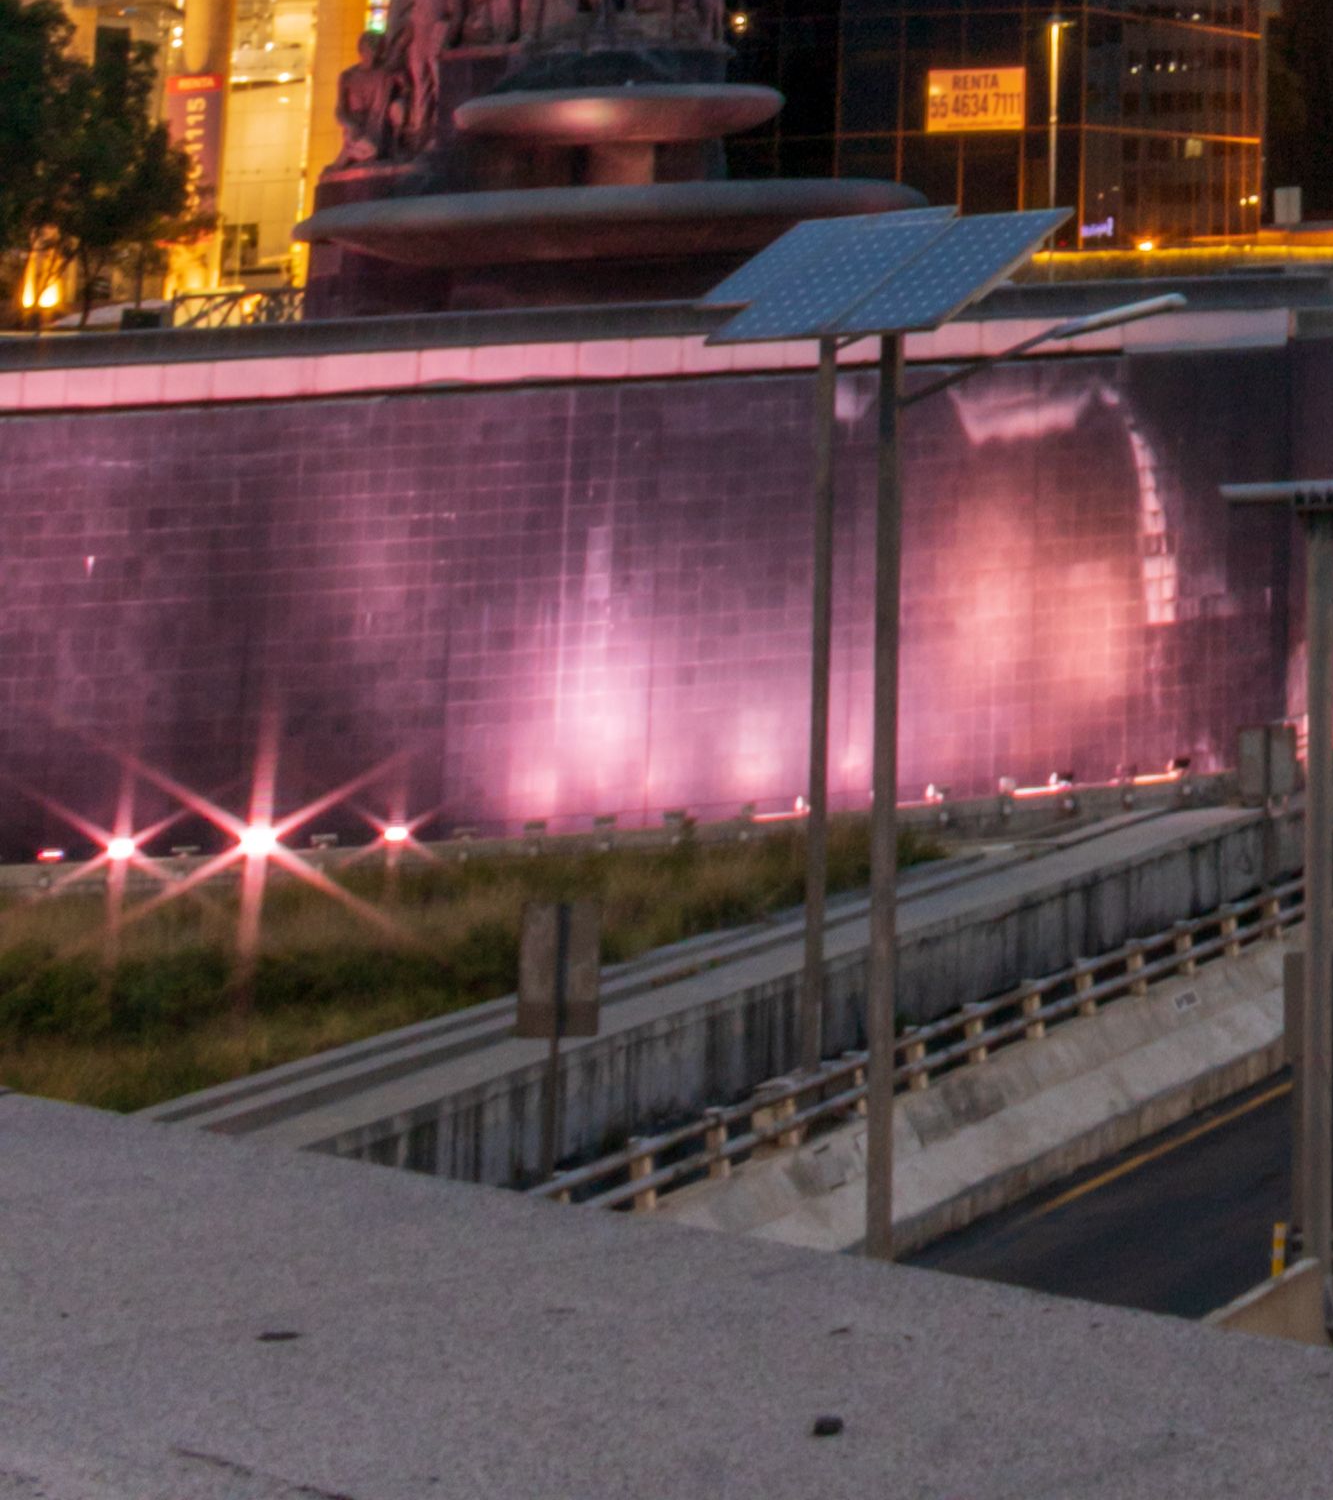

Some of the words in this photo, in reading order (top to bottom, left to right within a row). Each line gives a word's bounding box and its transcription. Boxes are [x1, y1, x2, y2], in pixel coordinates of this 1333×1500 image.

[952, 74, 999, 90] RENTA
[930, 93, 948, 118] 55
[993, 92, 1021, 116] 7111
